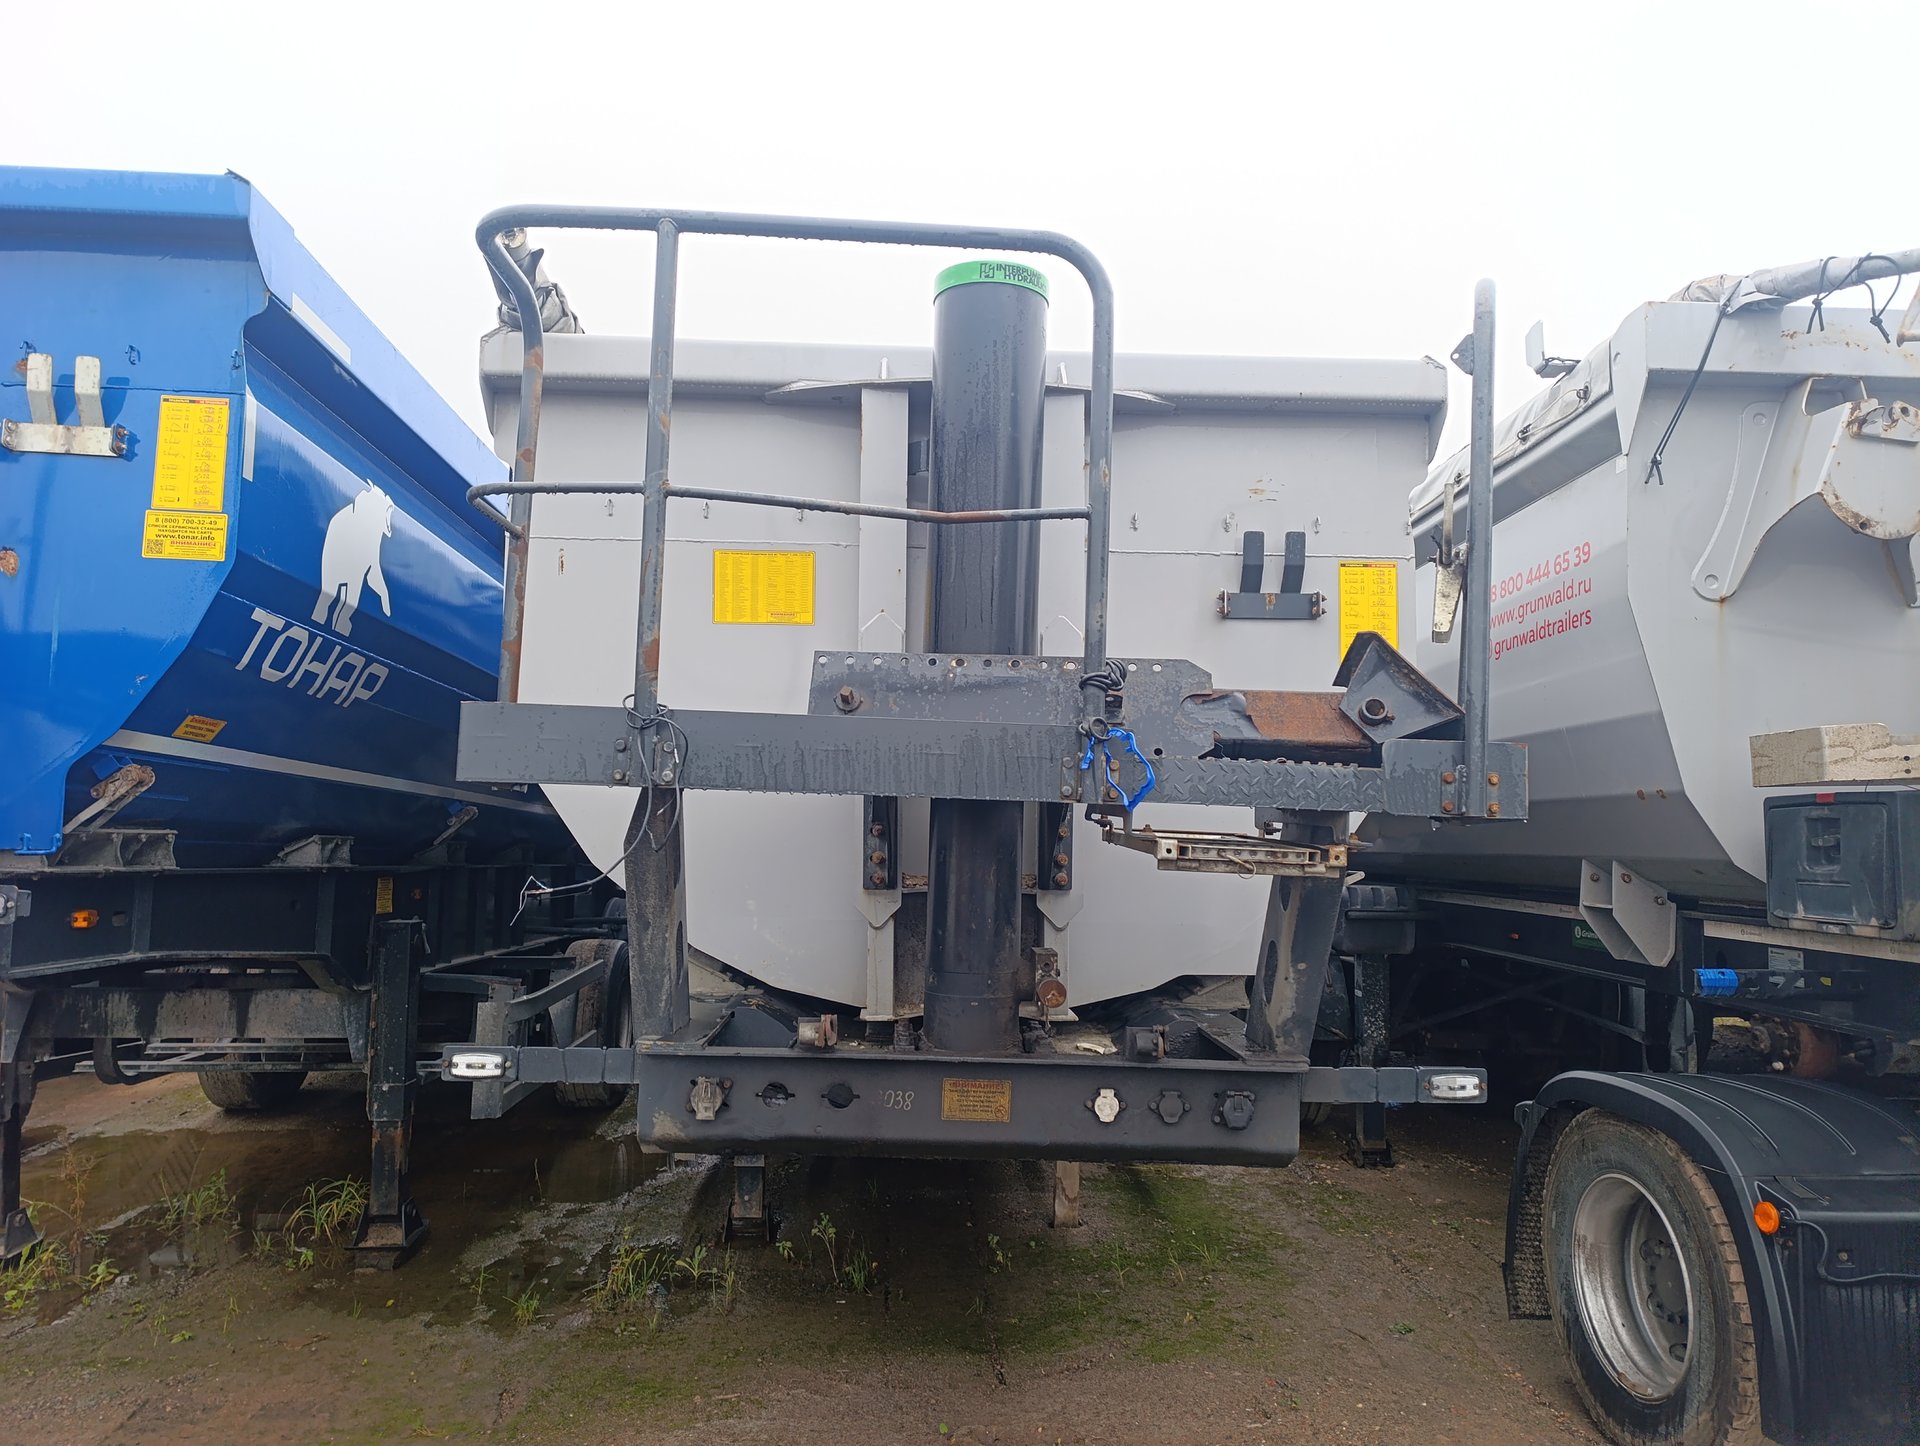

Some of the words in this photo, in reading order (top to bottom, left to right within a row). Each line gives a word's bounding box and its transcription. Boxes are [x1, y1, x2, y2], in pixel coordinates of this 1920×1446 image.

[996, 263, 1042, 279] INTERPUMP
[155, 533, 215, 541] www.tonar.info
[1490, 584, 1497, 603] 8
[1500, 572, 1523, 599] 800
[1526, 560, 1551, 586] 444
[1553, 550, 1570, 575] 65
[1574, 541, 1591, 567] 39
[235, 607, 390, 708] ТОНАР
[1495, 609, 1592, 660] grunwaldtrailers
